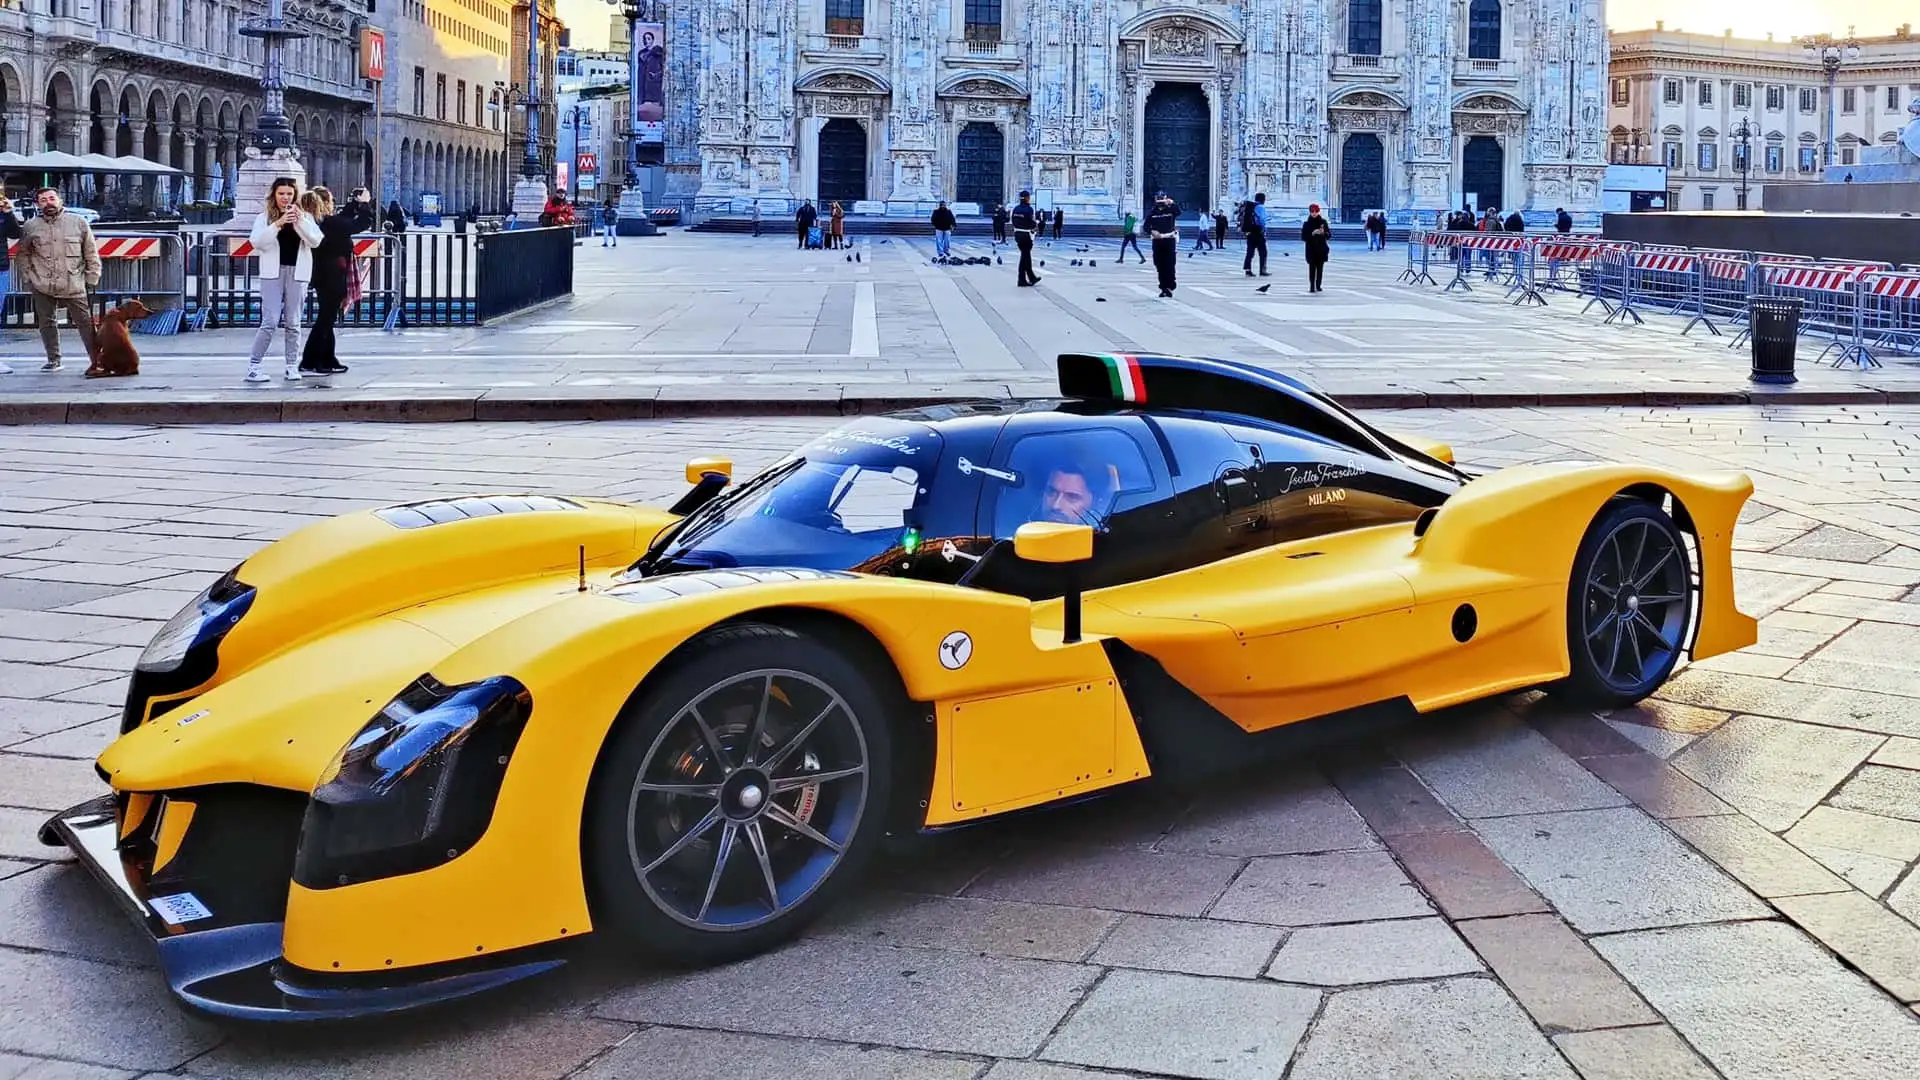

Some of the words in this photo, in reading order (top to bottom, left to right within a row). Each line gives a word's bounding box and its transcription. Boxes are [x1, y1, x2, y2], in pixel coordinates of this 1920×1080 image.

[370, 40, 382, 70] M
[580, 156, 594, 168] M
[1308, 488, 1346, 506] MILANO
